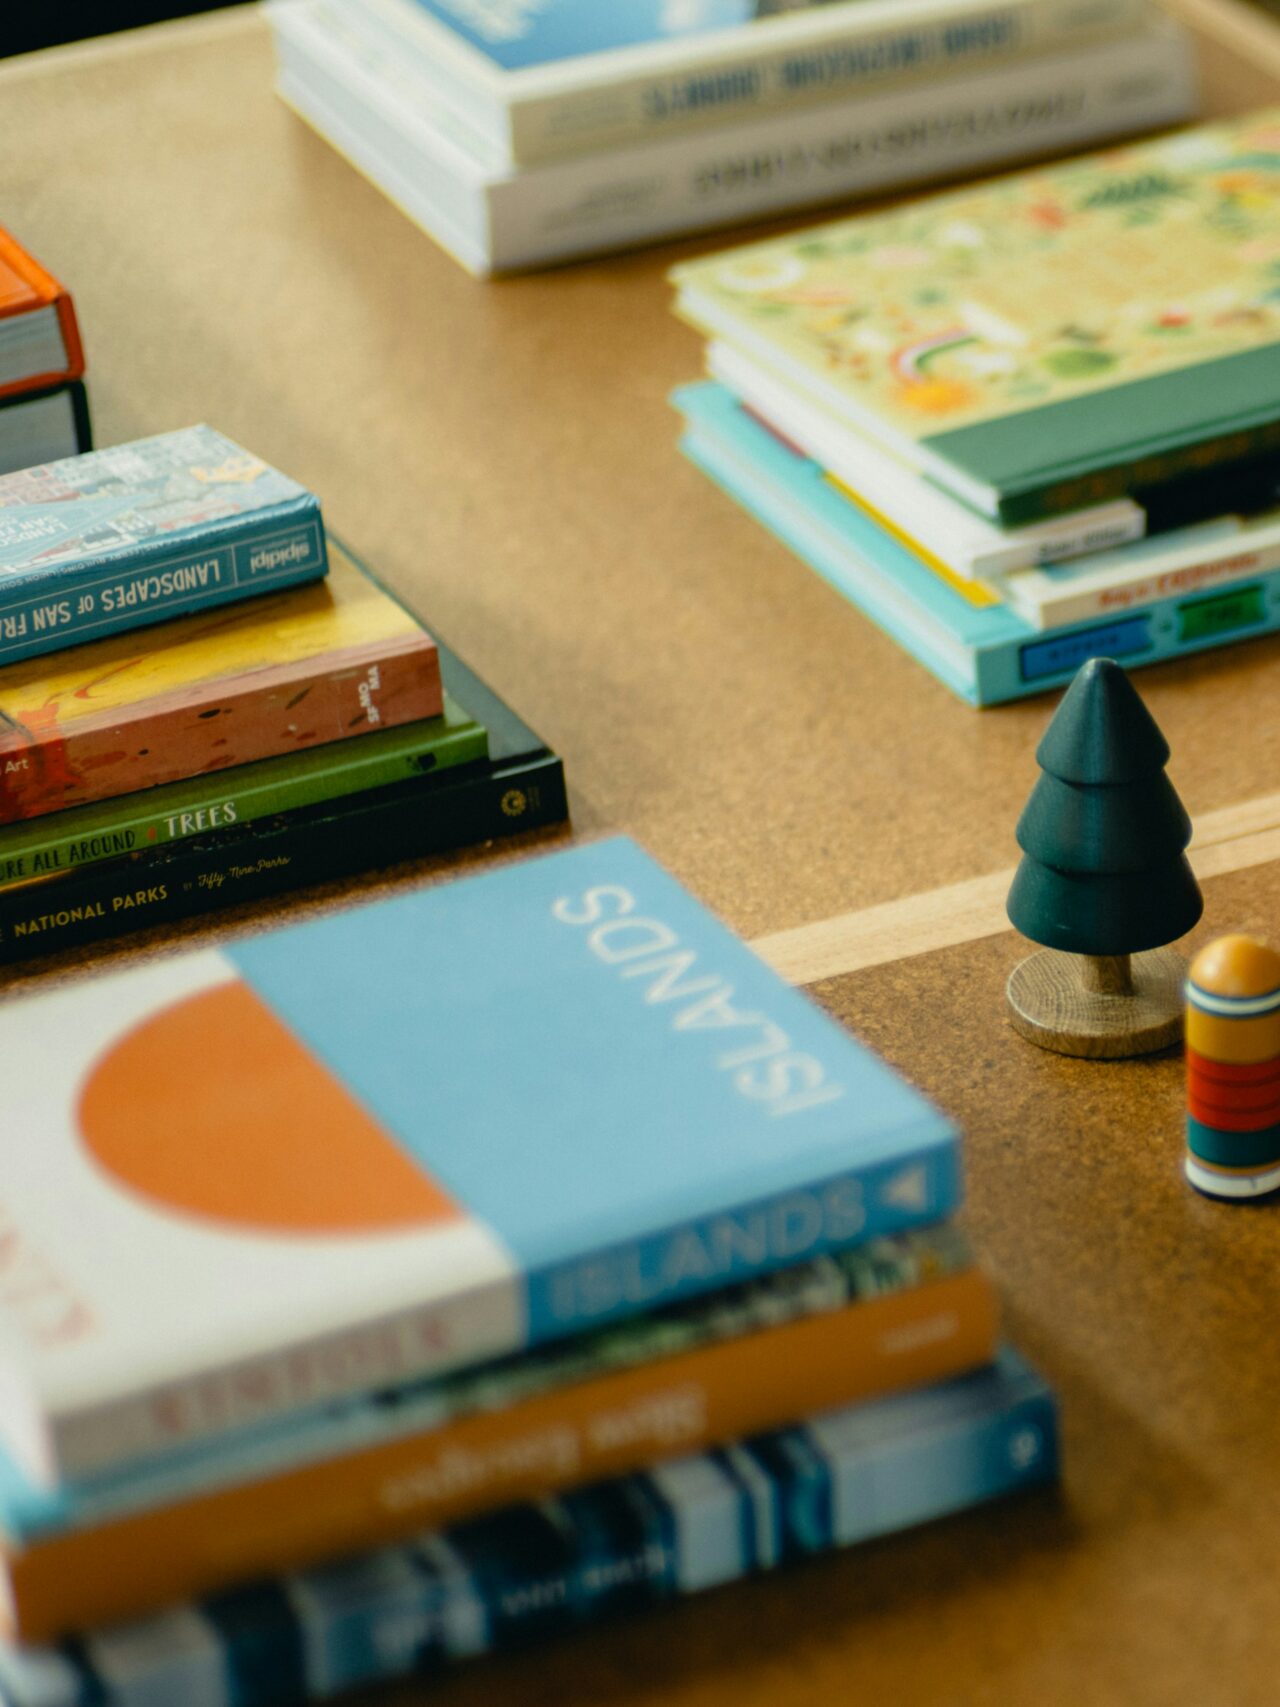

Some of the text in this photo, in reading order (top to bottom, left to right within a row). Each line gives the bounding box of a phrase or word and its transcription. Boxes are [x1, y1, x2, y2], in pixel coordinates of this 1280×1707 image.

[0, 559, 220, 642] LANDSCAPES OF SAN FR
[5, 759, 29, 774] Art
[33, 849, 62, 873] ALL
[69, 829, 136, 863] AROUND
[163, 801, 237, 838] TREES
[14, 902, 106, 938] NATIONAL
[112, 884, 168, 912] PARKS
[550, 883, 848, 1119] ISLANDS
[550, 1176, 868, 1317] ISLANDS
